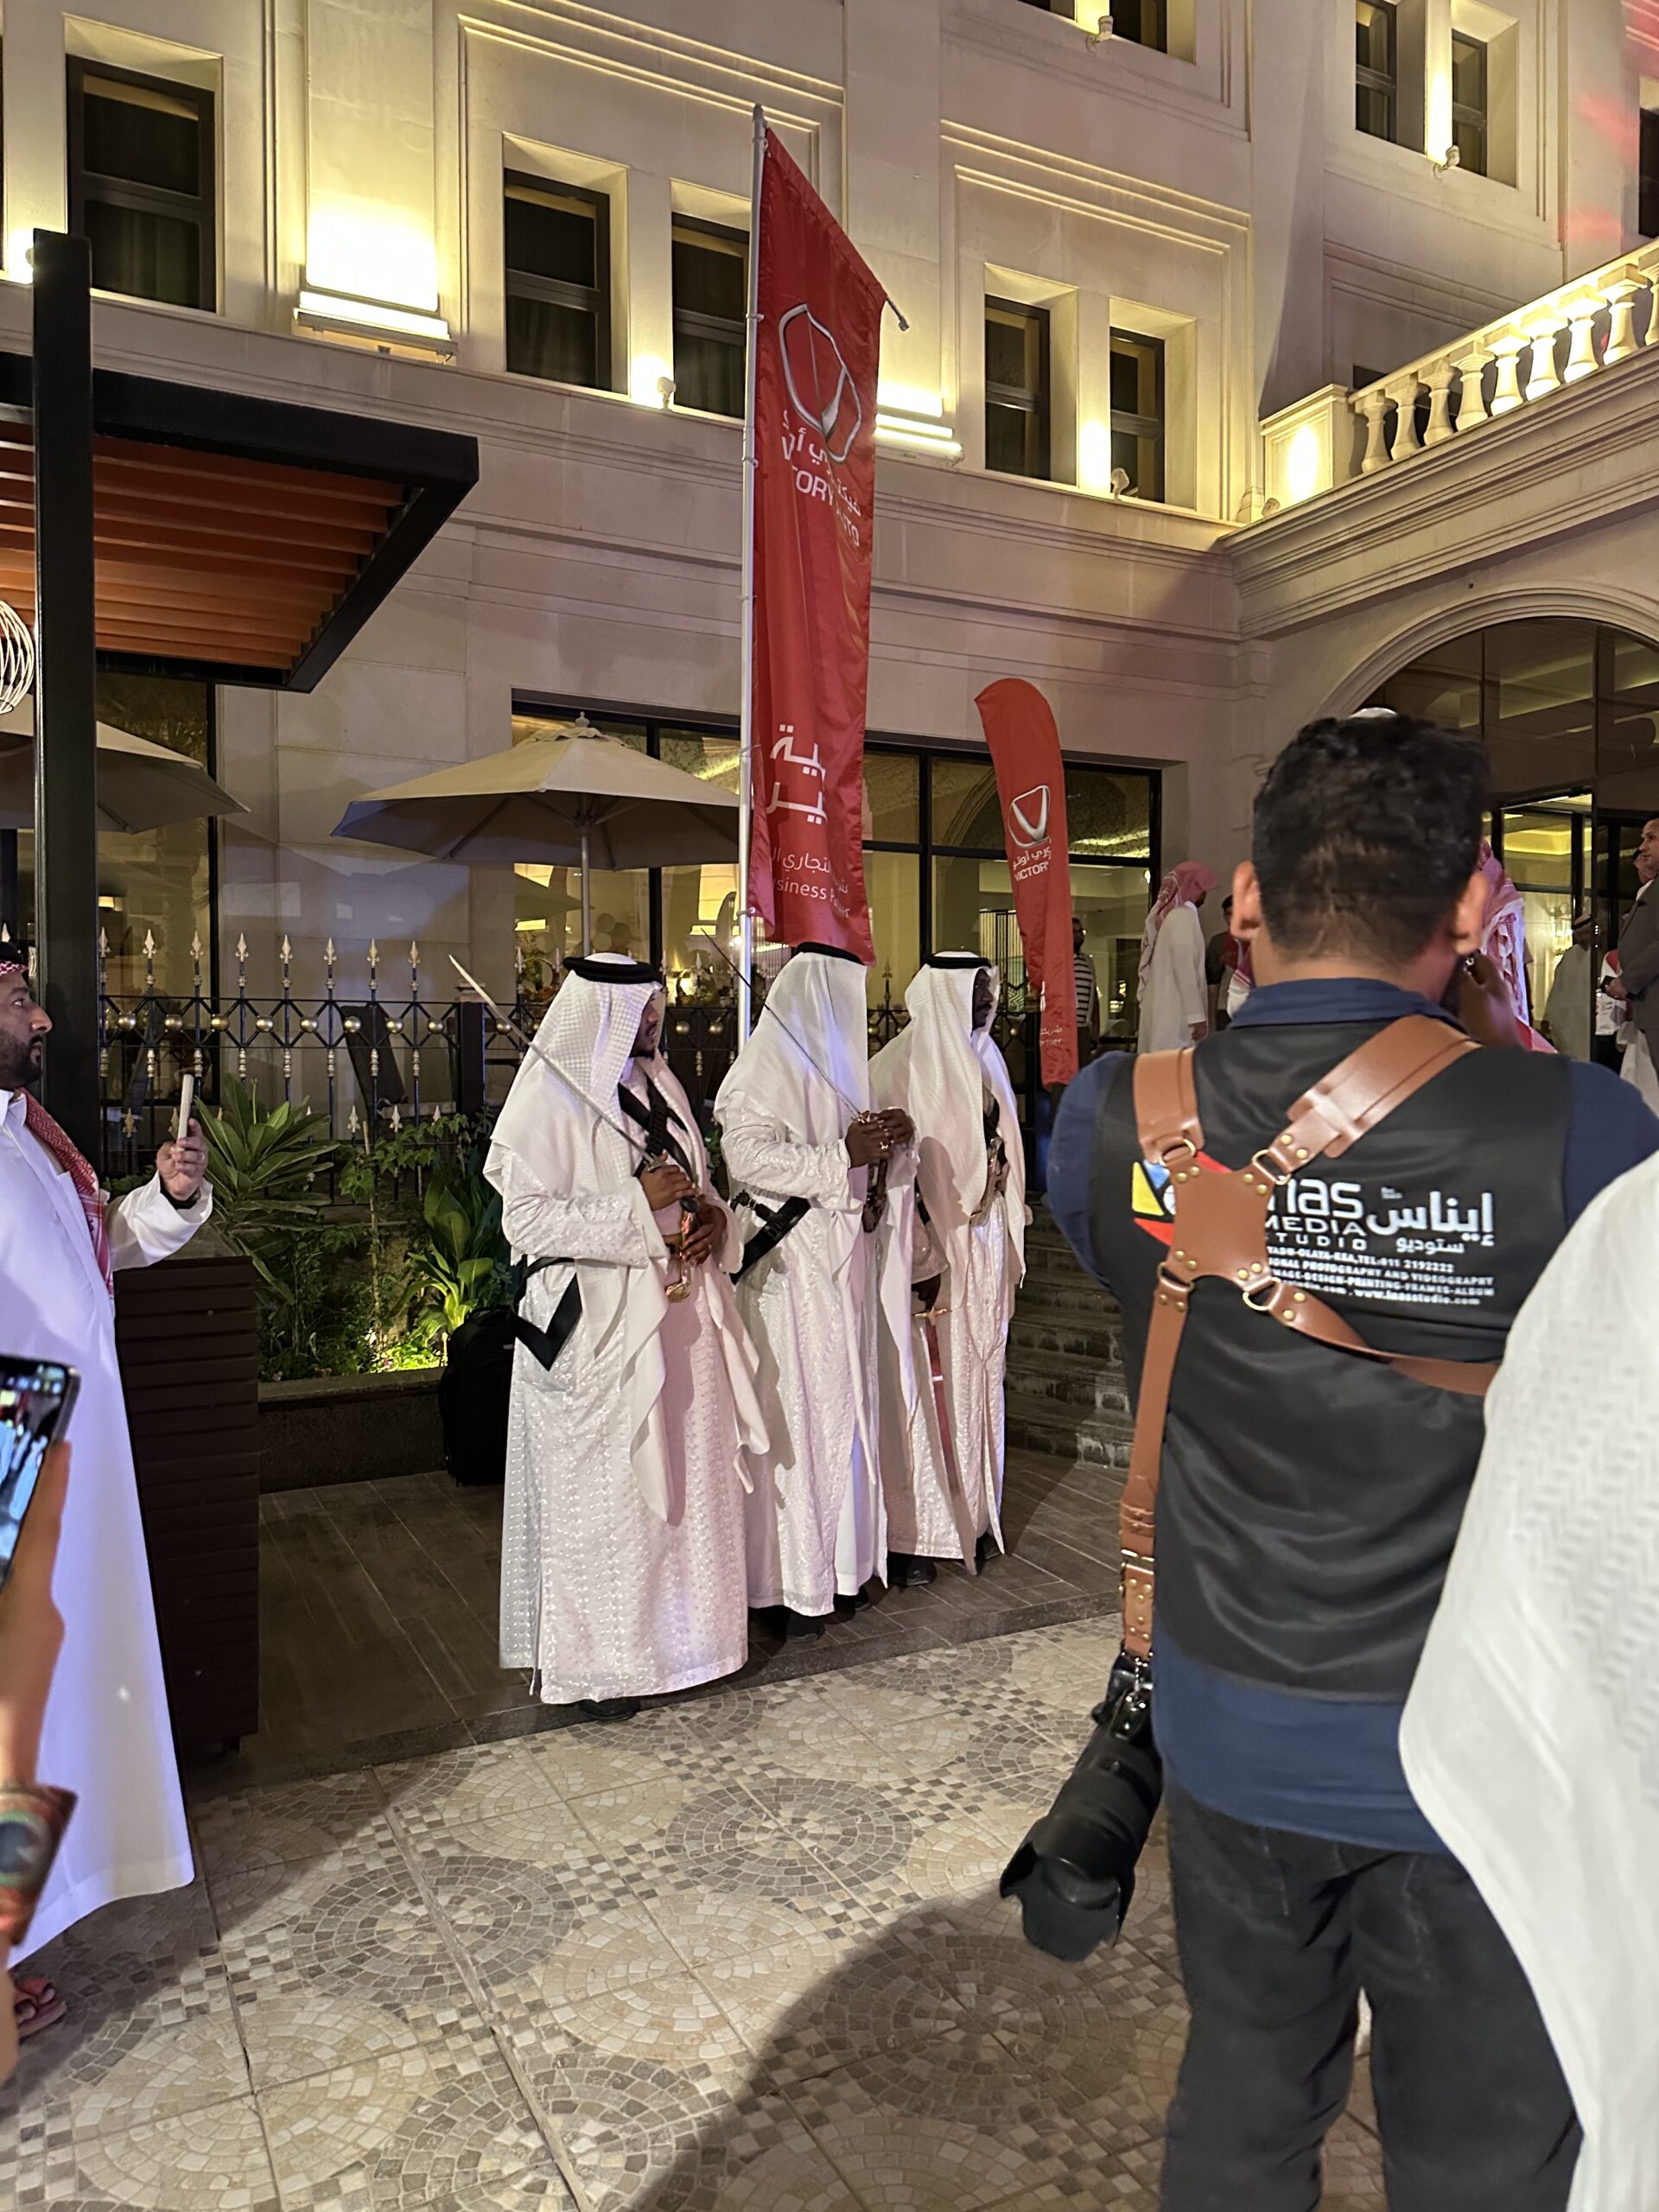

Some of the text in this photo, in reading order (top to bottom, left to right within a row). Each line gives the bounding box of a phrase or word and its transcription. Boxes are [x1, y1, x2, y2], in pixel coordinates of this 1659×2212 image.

[1014, 860, 1050, 882] VICTOR
[773, 877, 827, 900] siness
[1365, 1190, 1495, 1247] إيناس
[1265, 1231, 1368, 1251] TUDIO
[1395, 1236, 1465, 1255] ستوديو
[1302, 1259, 1382, 1278] PHOTOGRAPHY
[1383, 1268, 1410, 1281] AND
[1410, 1272, 1495, 1287] VIDEOGRAPHY
